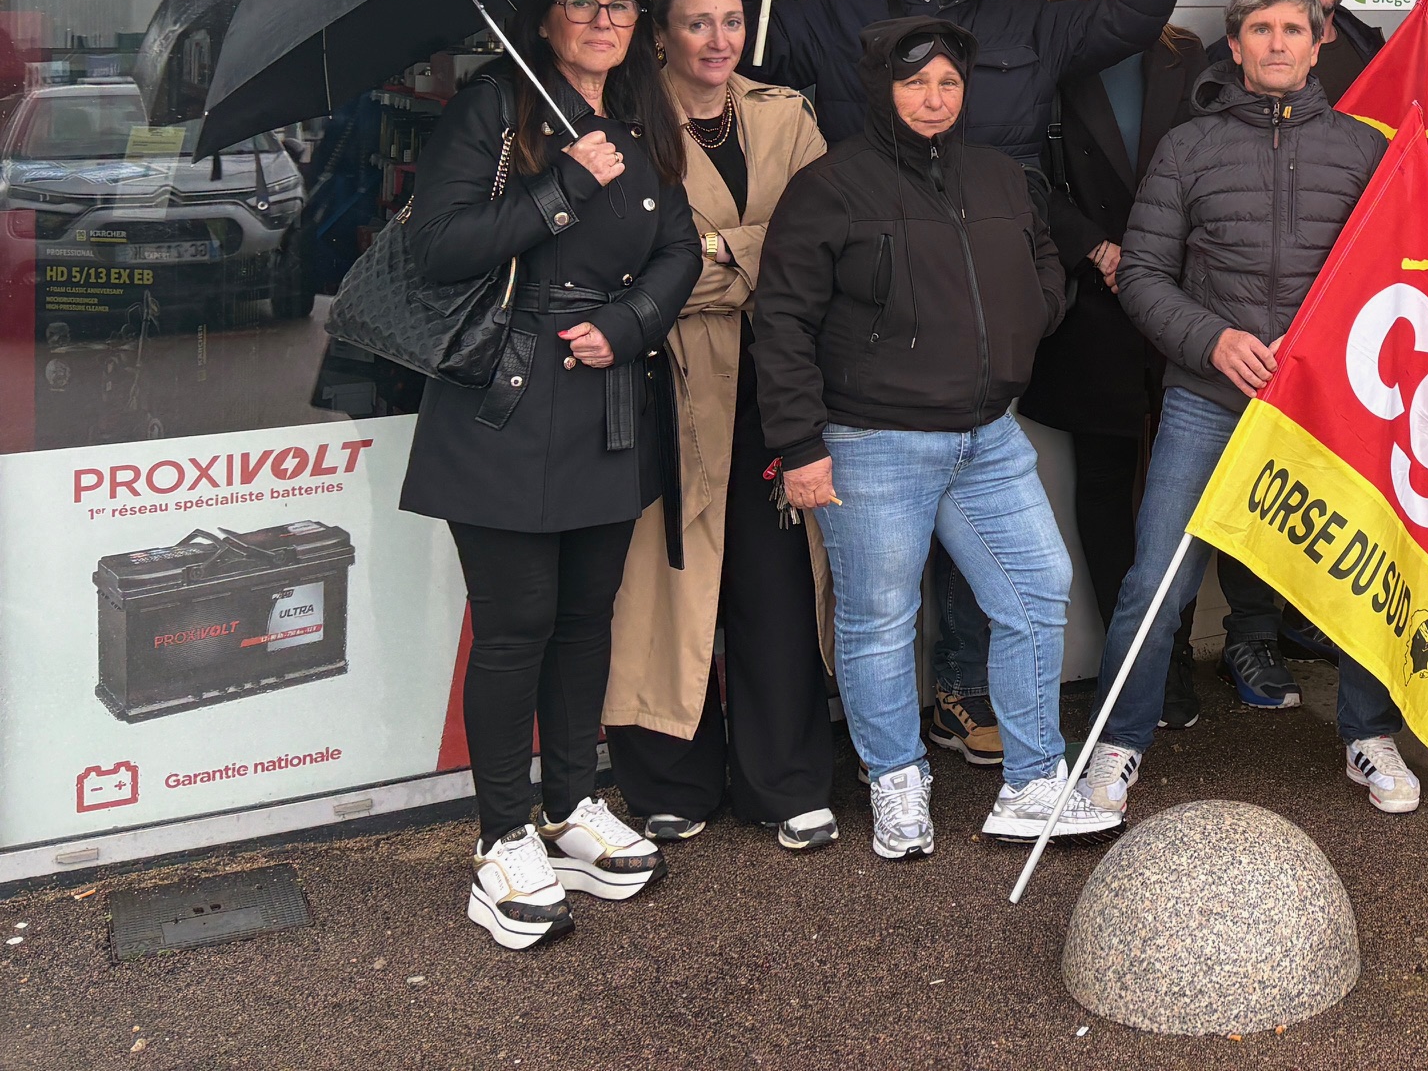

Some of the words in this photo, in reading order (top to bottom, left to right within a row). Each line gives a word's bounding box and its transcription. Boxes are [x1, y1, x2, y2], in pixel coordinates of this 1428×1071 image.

[46, 248, 95, 258] PROFESSIONAL
[46, 266, 68, 282] HD
[71, 267, 107, 285] 5/13
[110, 268, 131, 284] EX
[134, 269, 154, 285] EB
[73, 438, 374, 504] PROXIVOLT
[111, 501, 169, 519] réseau
[174, 490, 265, 512] spécialiste
[269, 482, 344, 500] batteries
[1248, 458, 1349, 565] CORSE
[1327, 528, 1387, 597] DU
[1371, 560, 1412, 639] SUD
[278, 604, 315, 619] ULTRA
[154, 620, 240, 649] PROXIVOLT
[164, 762, 249, 789] Garantie
[253, 747, 343, 775] nationale
